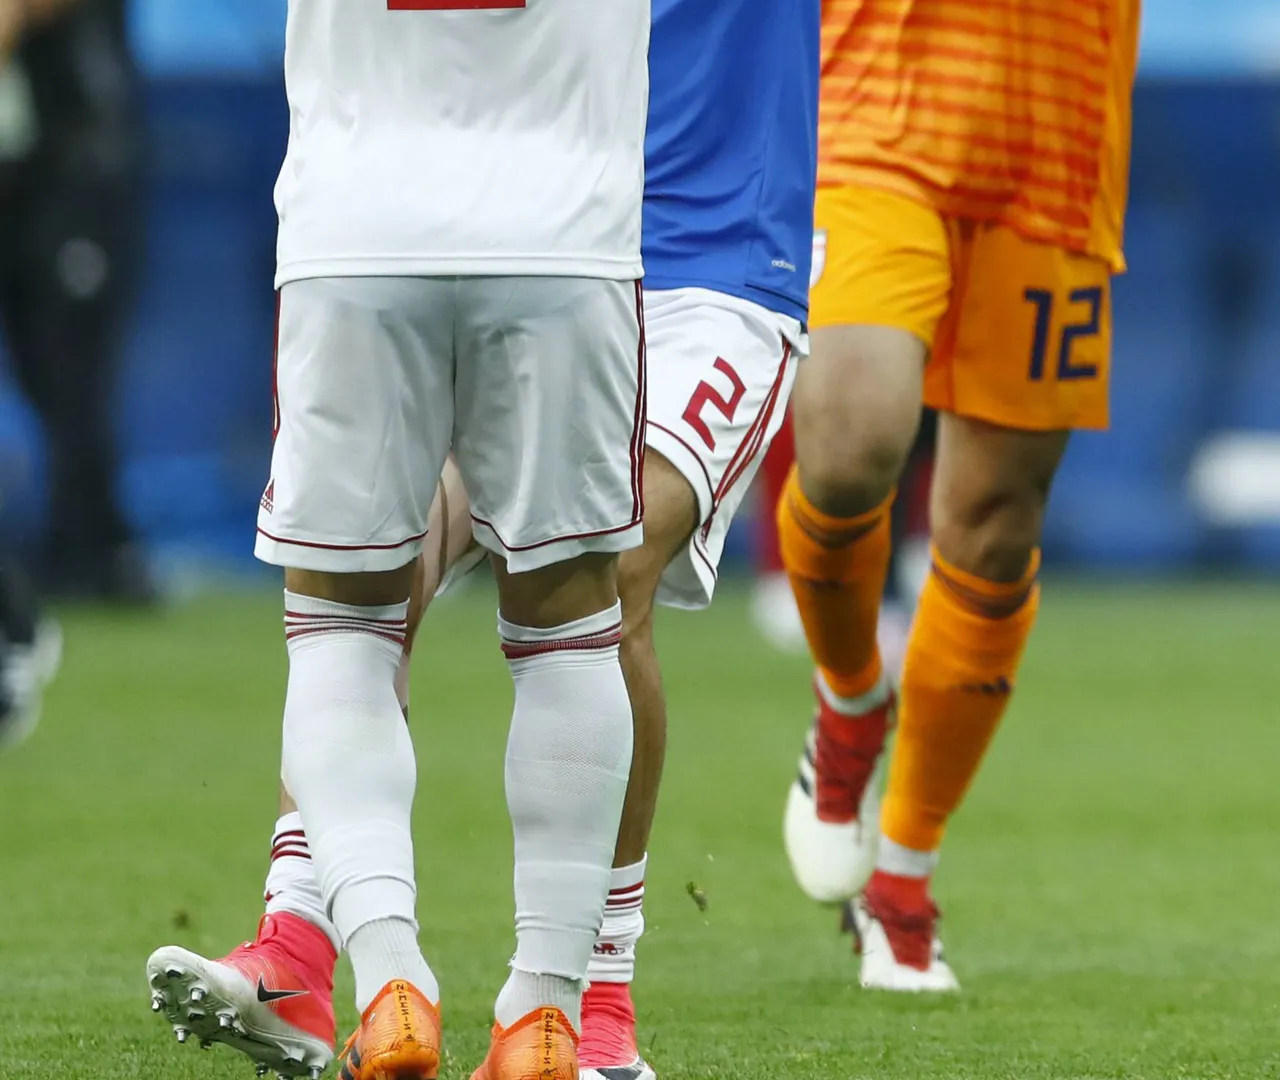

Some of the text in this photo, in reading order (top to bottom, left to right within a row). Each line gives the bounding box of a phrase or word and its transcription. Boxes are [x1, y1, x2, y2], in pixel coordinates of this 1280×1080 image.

[1024, 286, 1102, 381] 12
[681, 356, 748, 453] 2
[396, 983, 411, 1031] NMEZIZ
